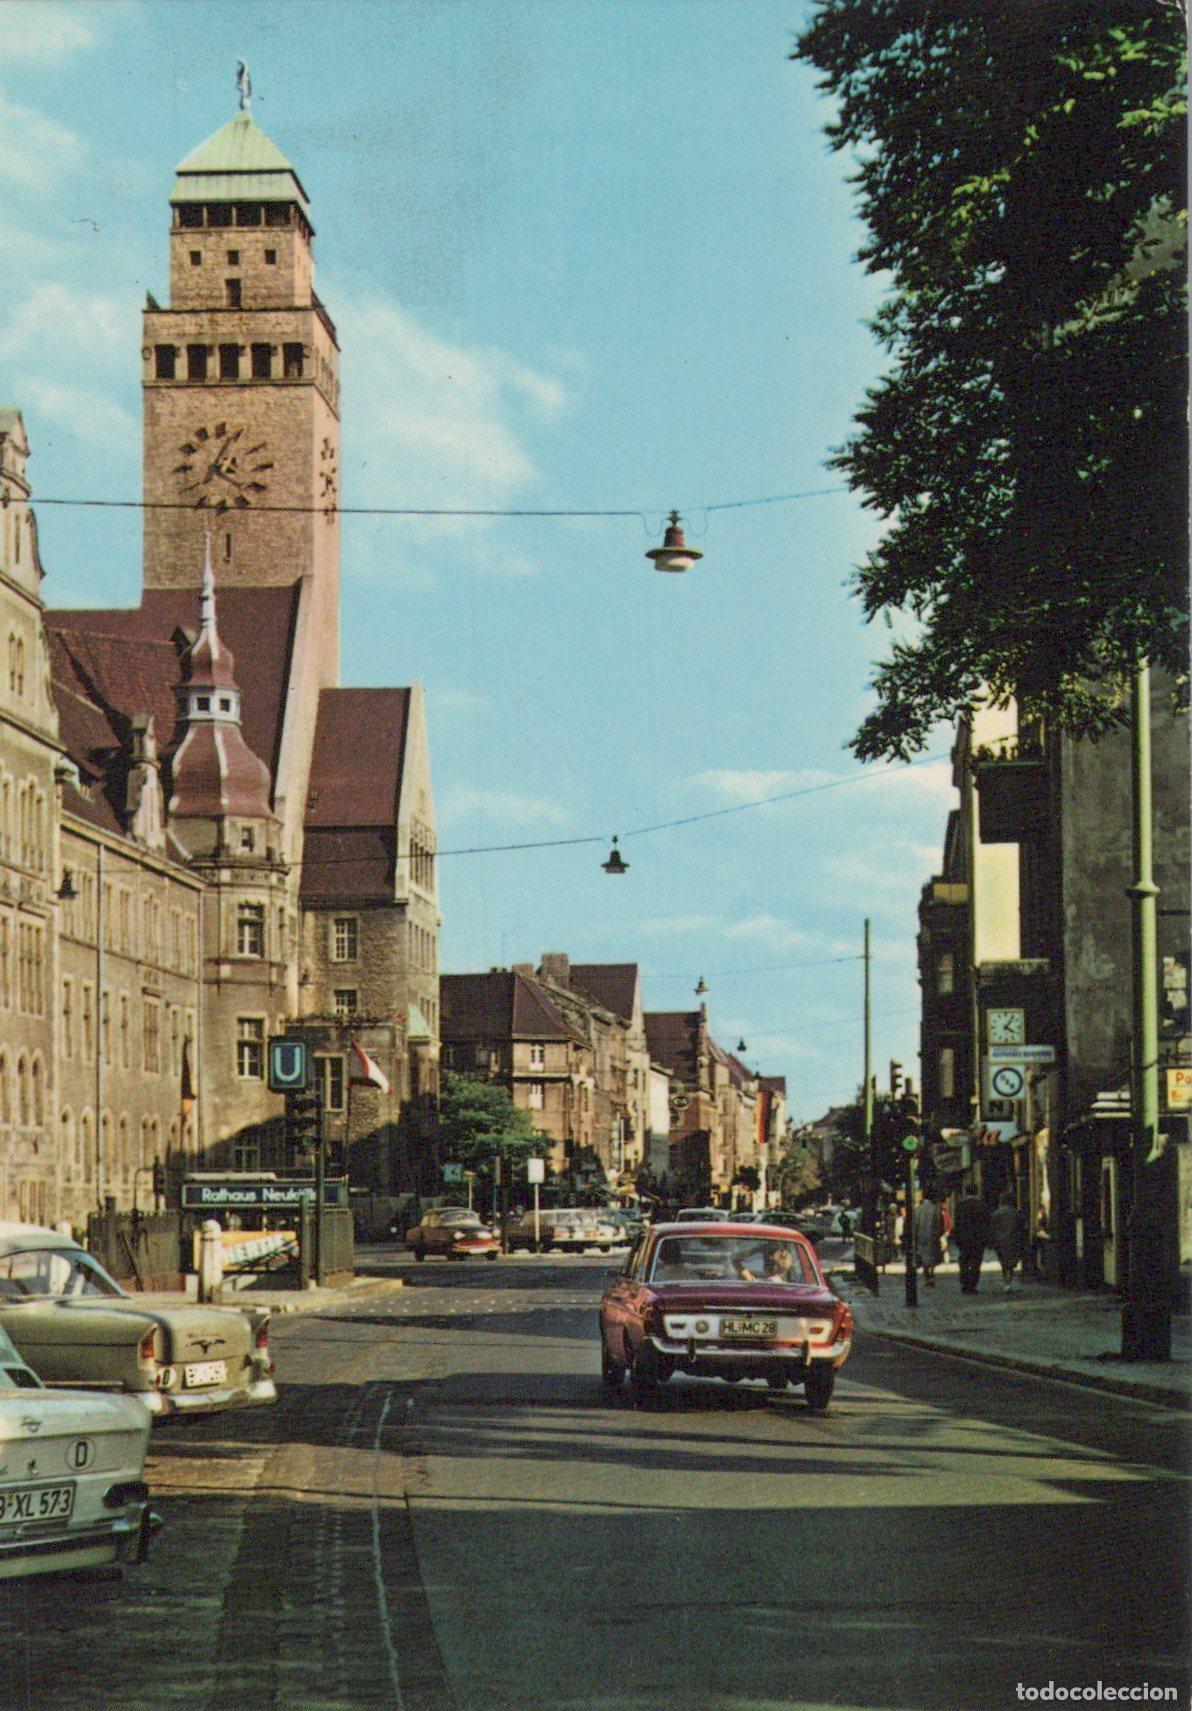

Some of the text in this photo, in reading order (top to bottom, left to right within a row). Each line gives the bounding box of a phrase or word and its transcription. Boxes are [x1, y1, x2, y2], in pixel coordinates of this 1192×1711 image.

[273, 1045, 301, 1082] U
[201, 1186, 314, 1202] Rathaus Neukll
[39, 1489, 71, 1515] 573
